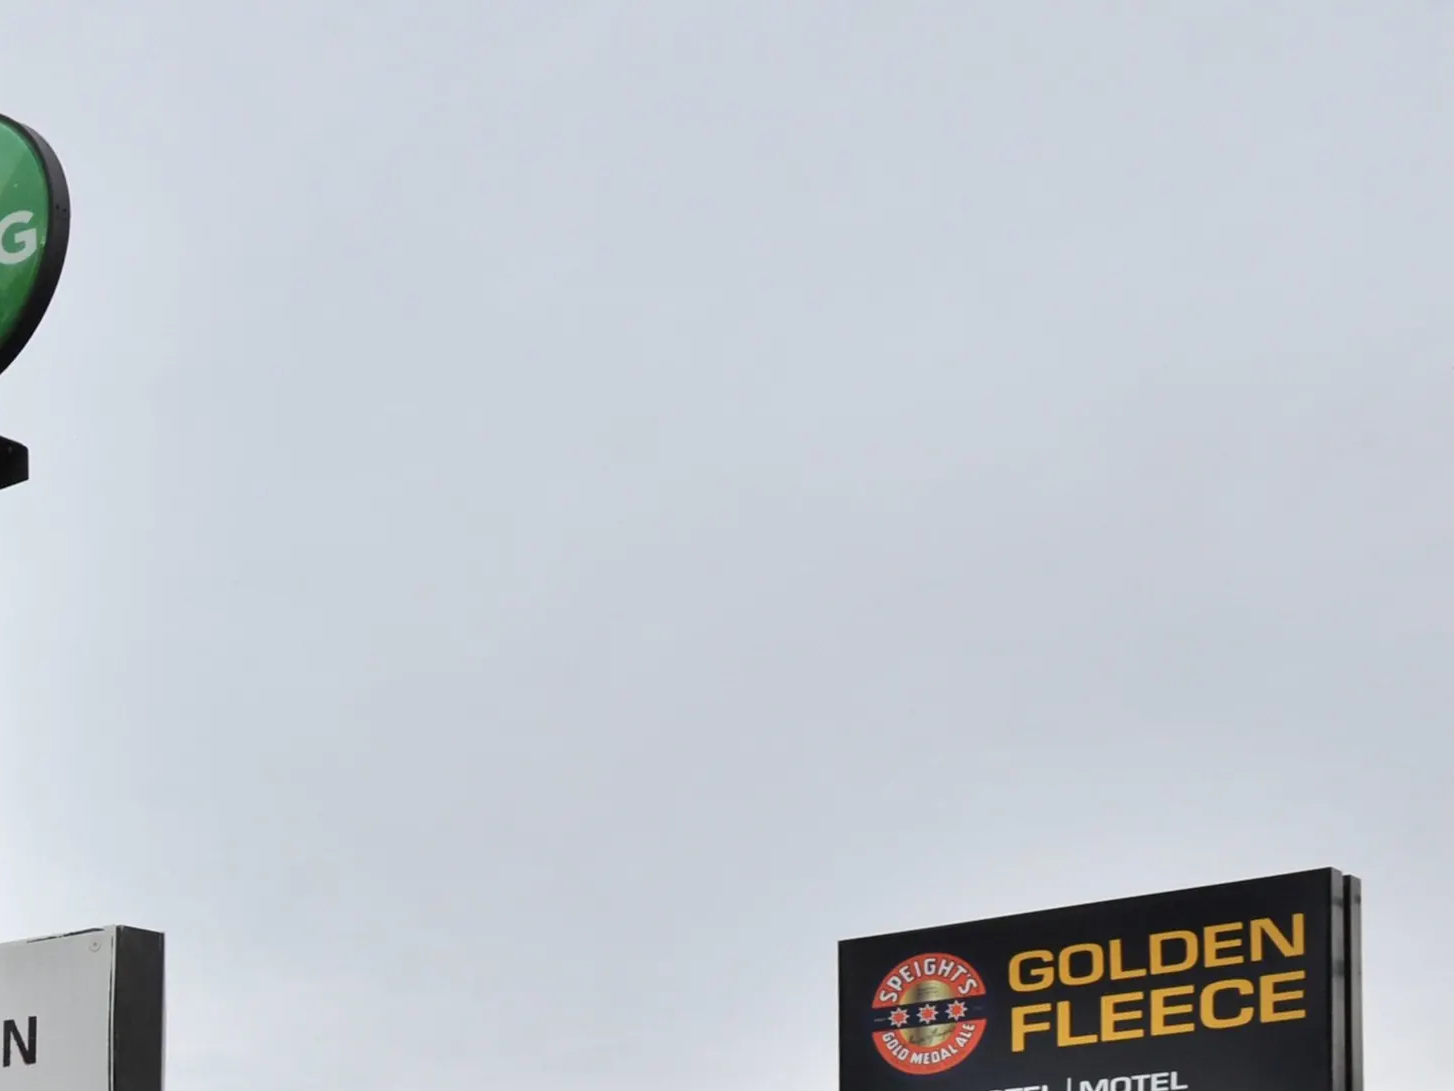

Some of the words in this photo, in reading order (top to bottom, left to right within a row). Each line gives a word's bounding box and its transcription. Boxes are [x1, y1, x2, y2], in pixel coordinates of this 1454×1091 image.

[879, 958, 978, 1004] SPEIGHT'S
[1008, 912, 1306, 994] GOLDEN
[882, 1032, 910, 1061] GOLD
[909, 1044, 958, 1065] MEDAL
[955, 1023, 976, 1048] ALE
[1011, 970, 1307, 1054] FLEECE
